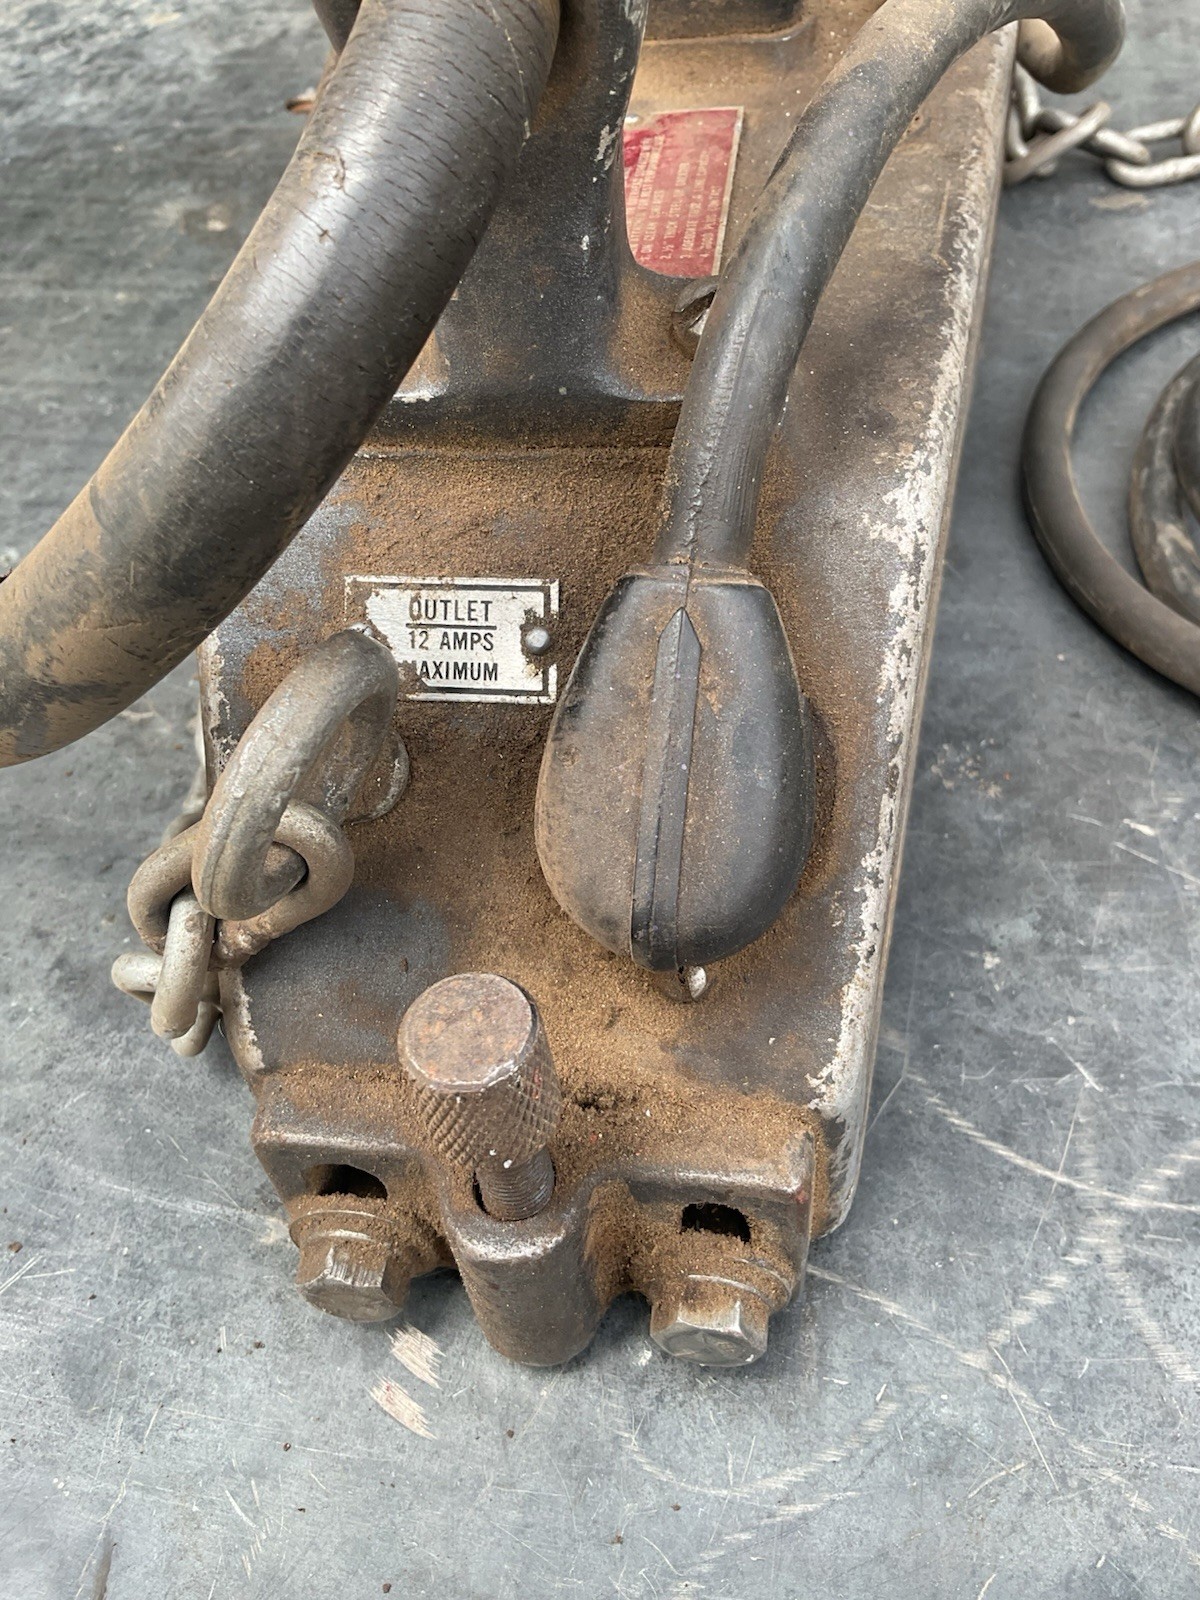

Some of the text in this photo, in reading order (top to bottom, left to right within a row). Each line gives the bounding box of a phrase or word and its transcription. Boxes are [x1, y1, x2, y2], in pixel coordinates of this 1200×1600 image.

[682, 221, 698, 251] ADEQUATE
[408, 596, 493, 622] OUTLET
[408, 630, 495, 652] 12 AMPS
